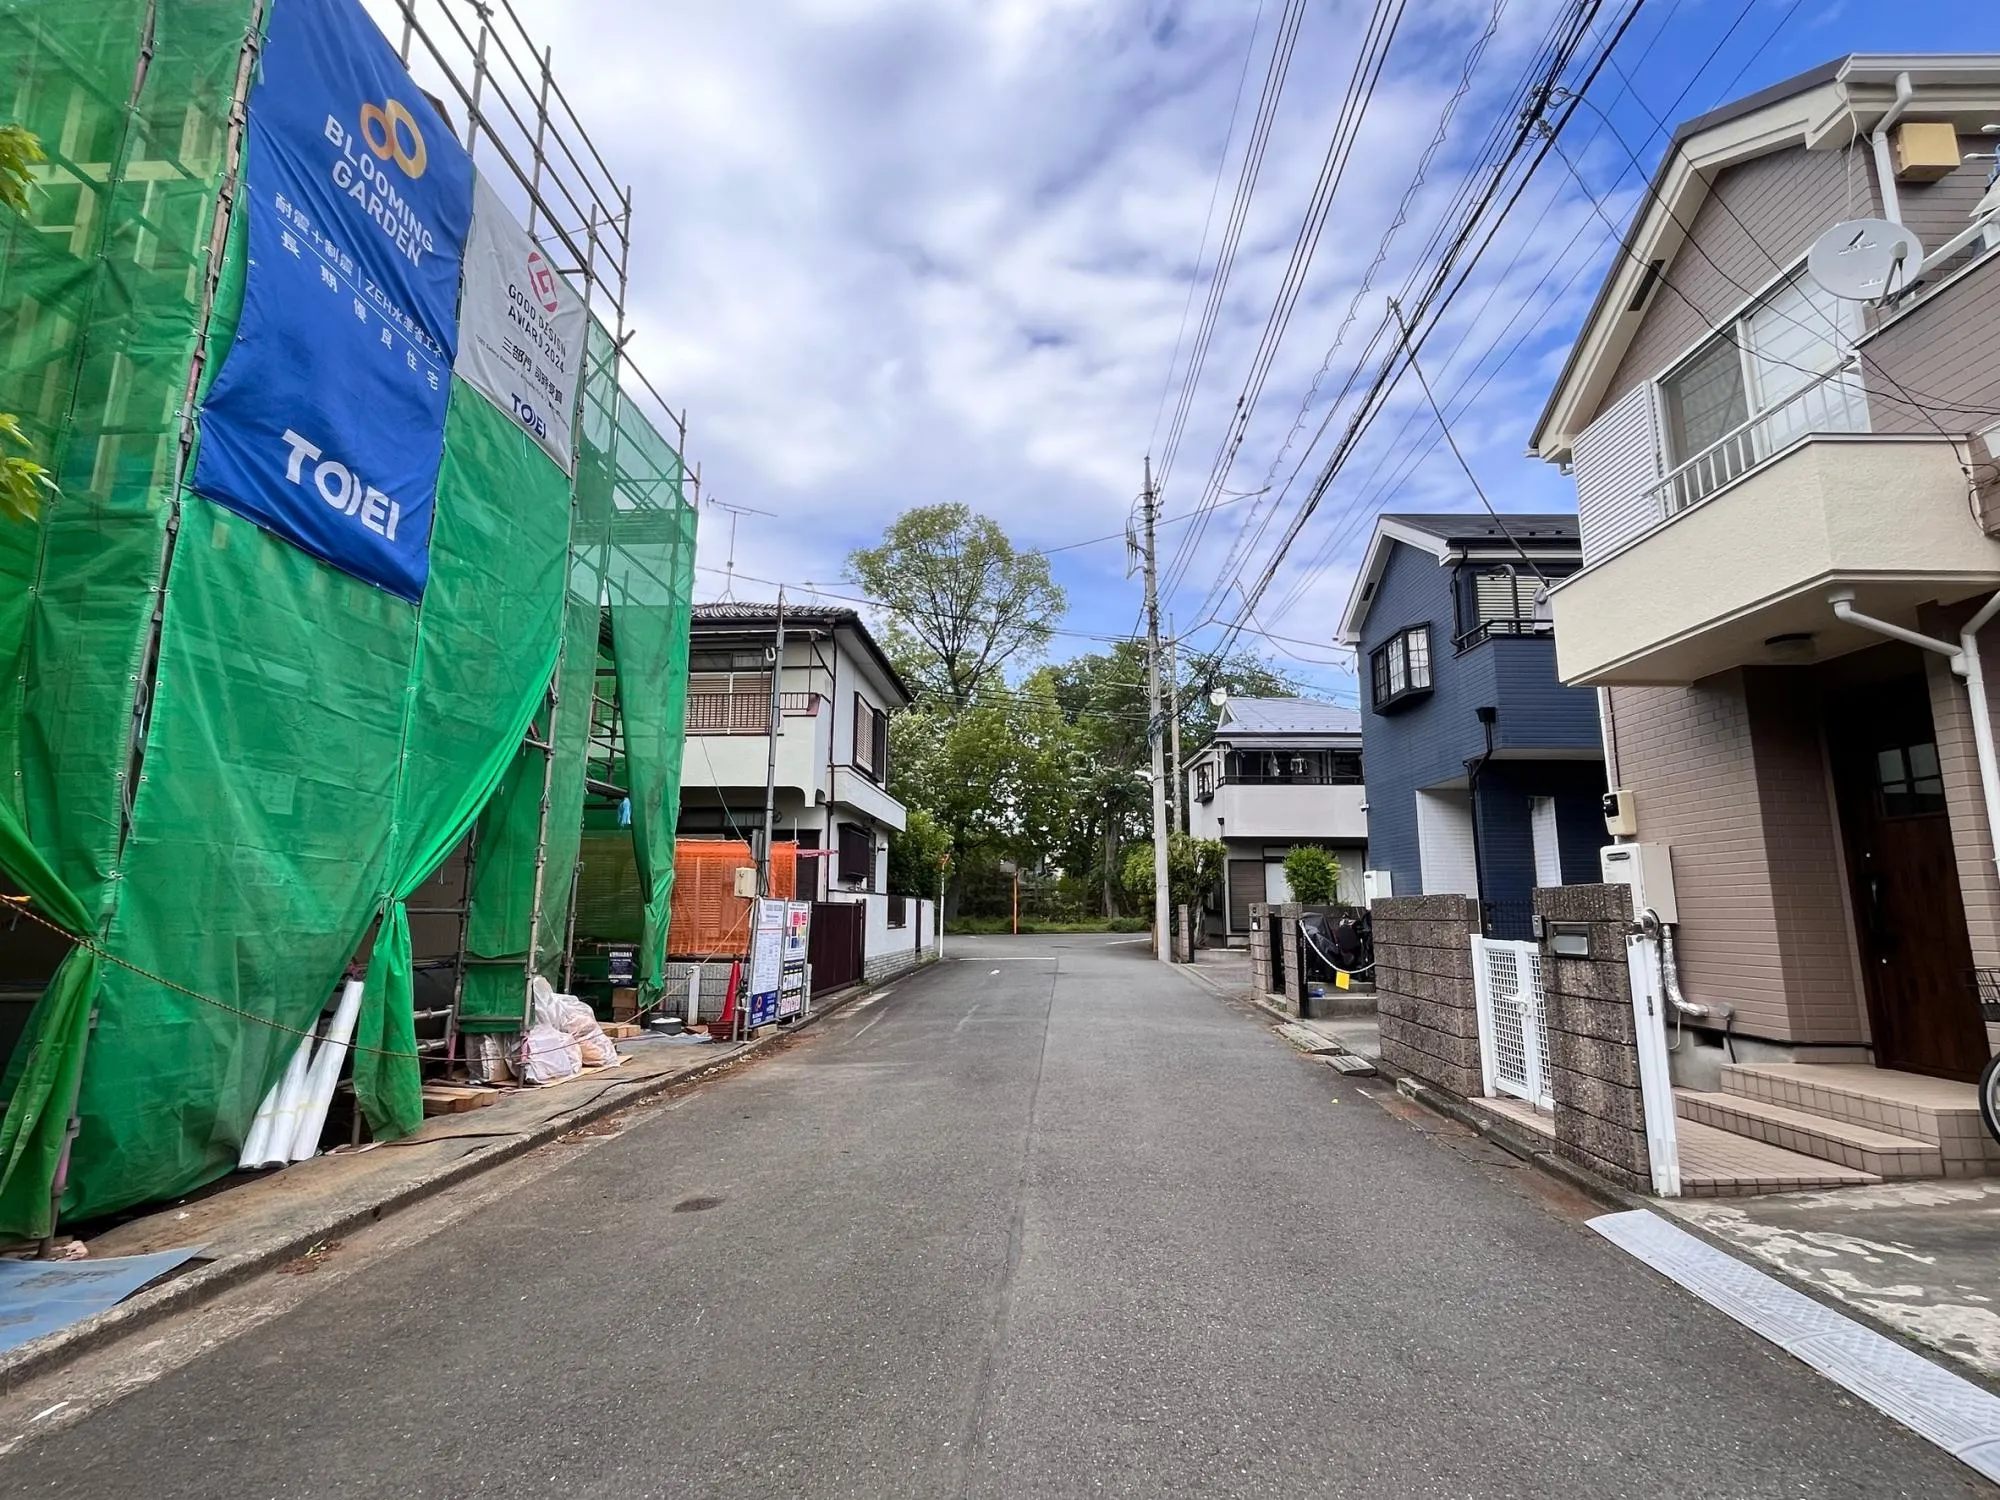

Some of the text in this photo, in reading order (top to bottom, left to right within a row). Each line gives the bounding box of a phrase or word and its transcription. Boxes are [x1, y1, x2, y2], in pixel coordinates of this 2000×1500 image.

[324, 113, 434, 253] BLOOMING
[332, 160, 422, 268] GARDEN
[502, 336, 532, 372] 三部門
[508, 283, 566, 357] GOOD DESIGN
[508, 305, 543, 348] AWARD
[544, 343, 565, 373] 2024
